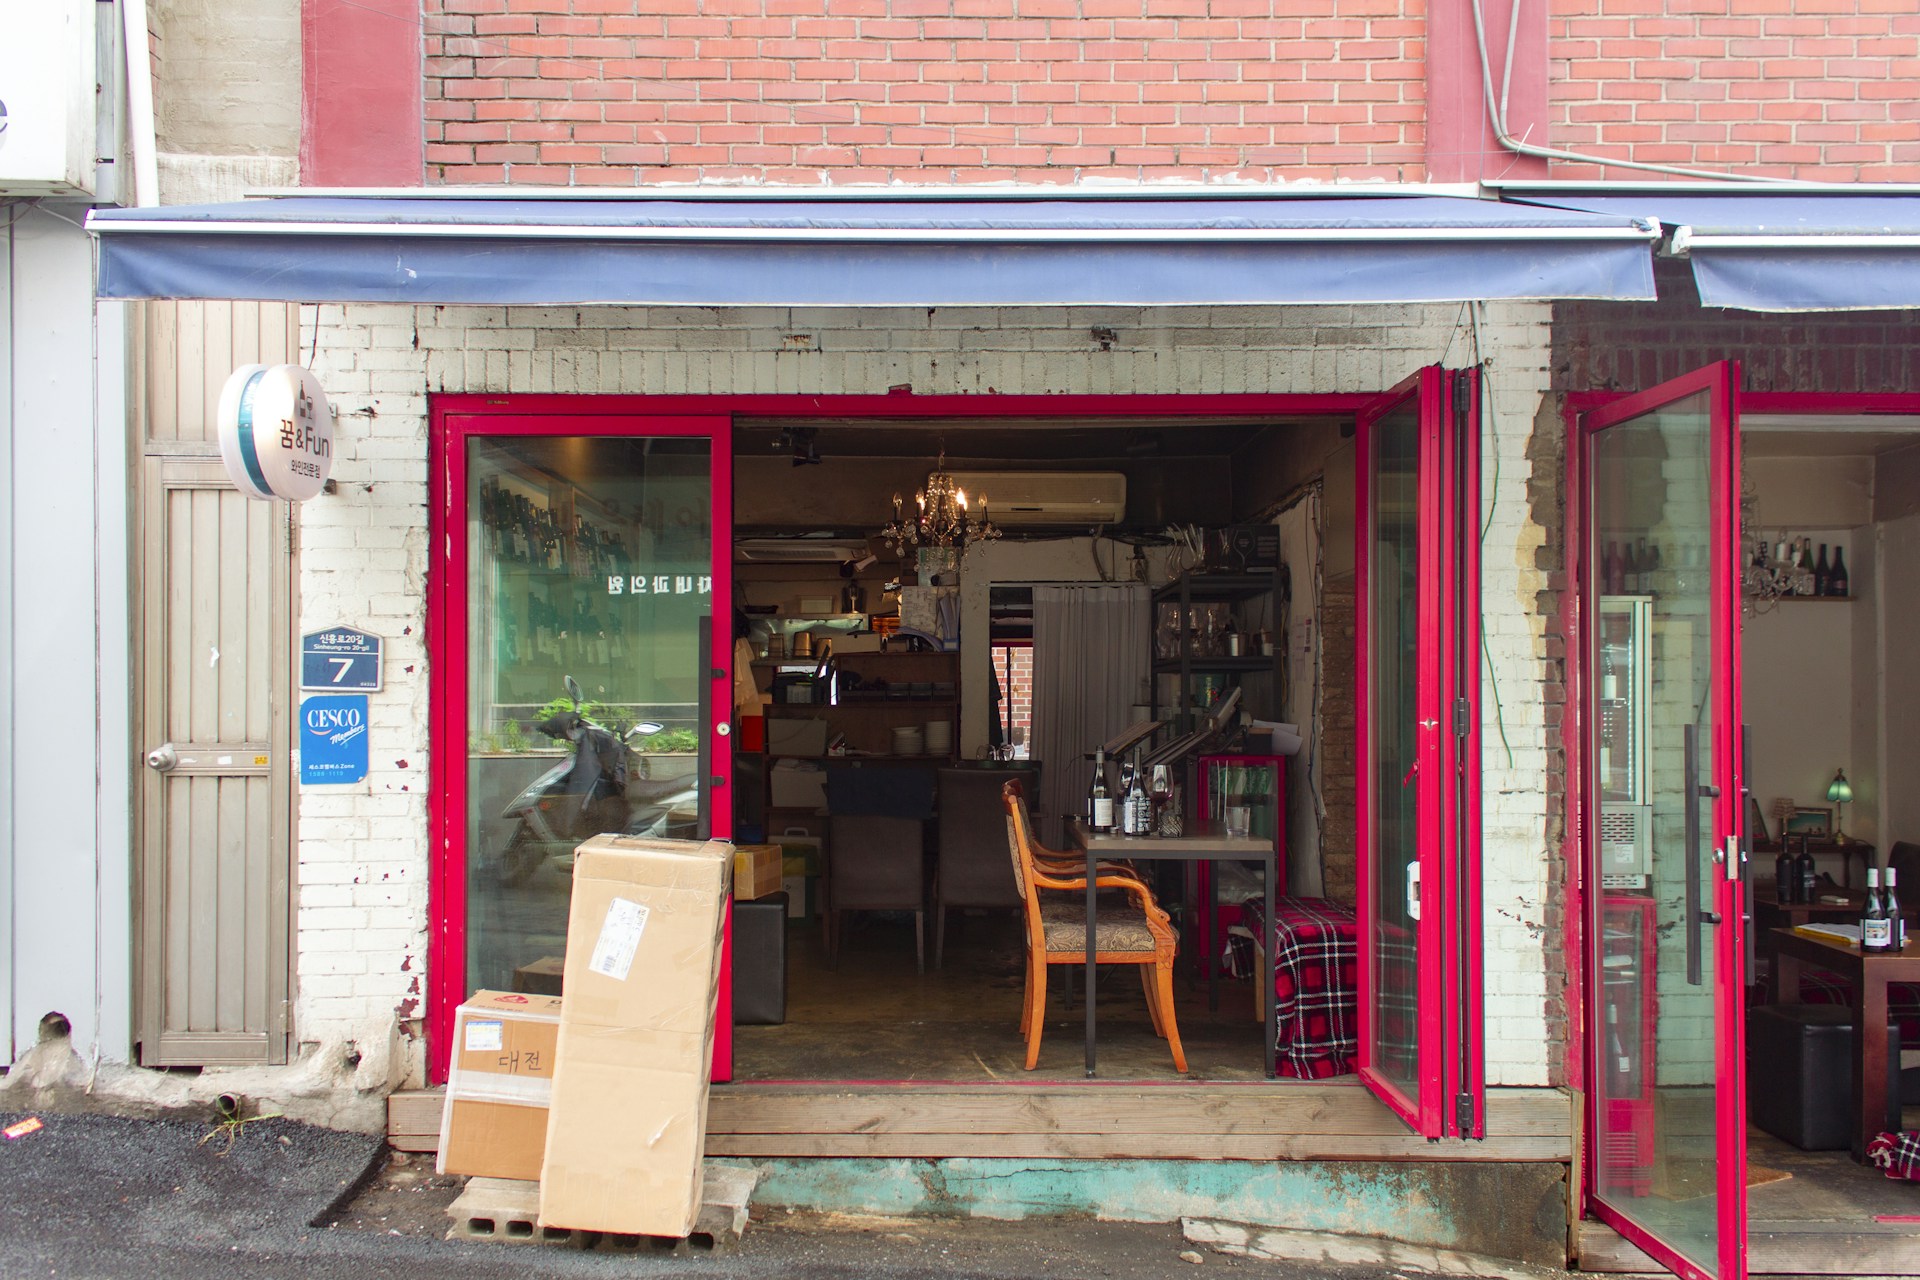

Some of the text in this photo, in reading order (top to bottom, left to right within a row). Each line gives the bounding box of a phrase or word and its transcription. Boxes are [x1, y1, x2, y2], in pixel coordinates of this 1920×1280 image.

[291, 459, 321, 479] 와인전문점
[313, 643, 351, 651] Sinheung-ro
[320, 634, 364, 645] 신흥로20길
[328, 657, 354, 683] 7
[307, 708, 360, 728] CESCO
[498, 1050, 542, 1073] 대전
